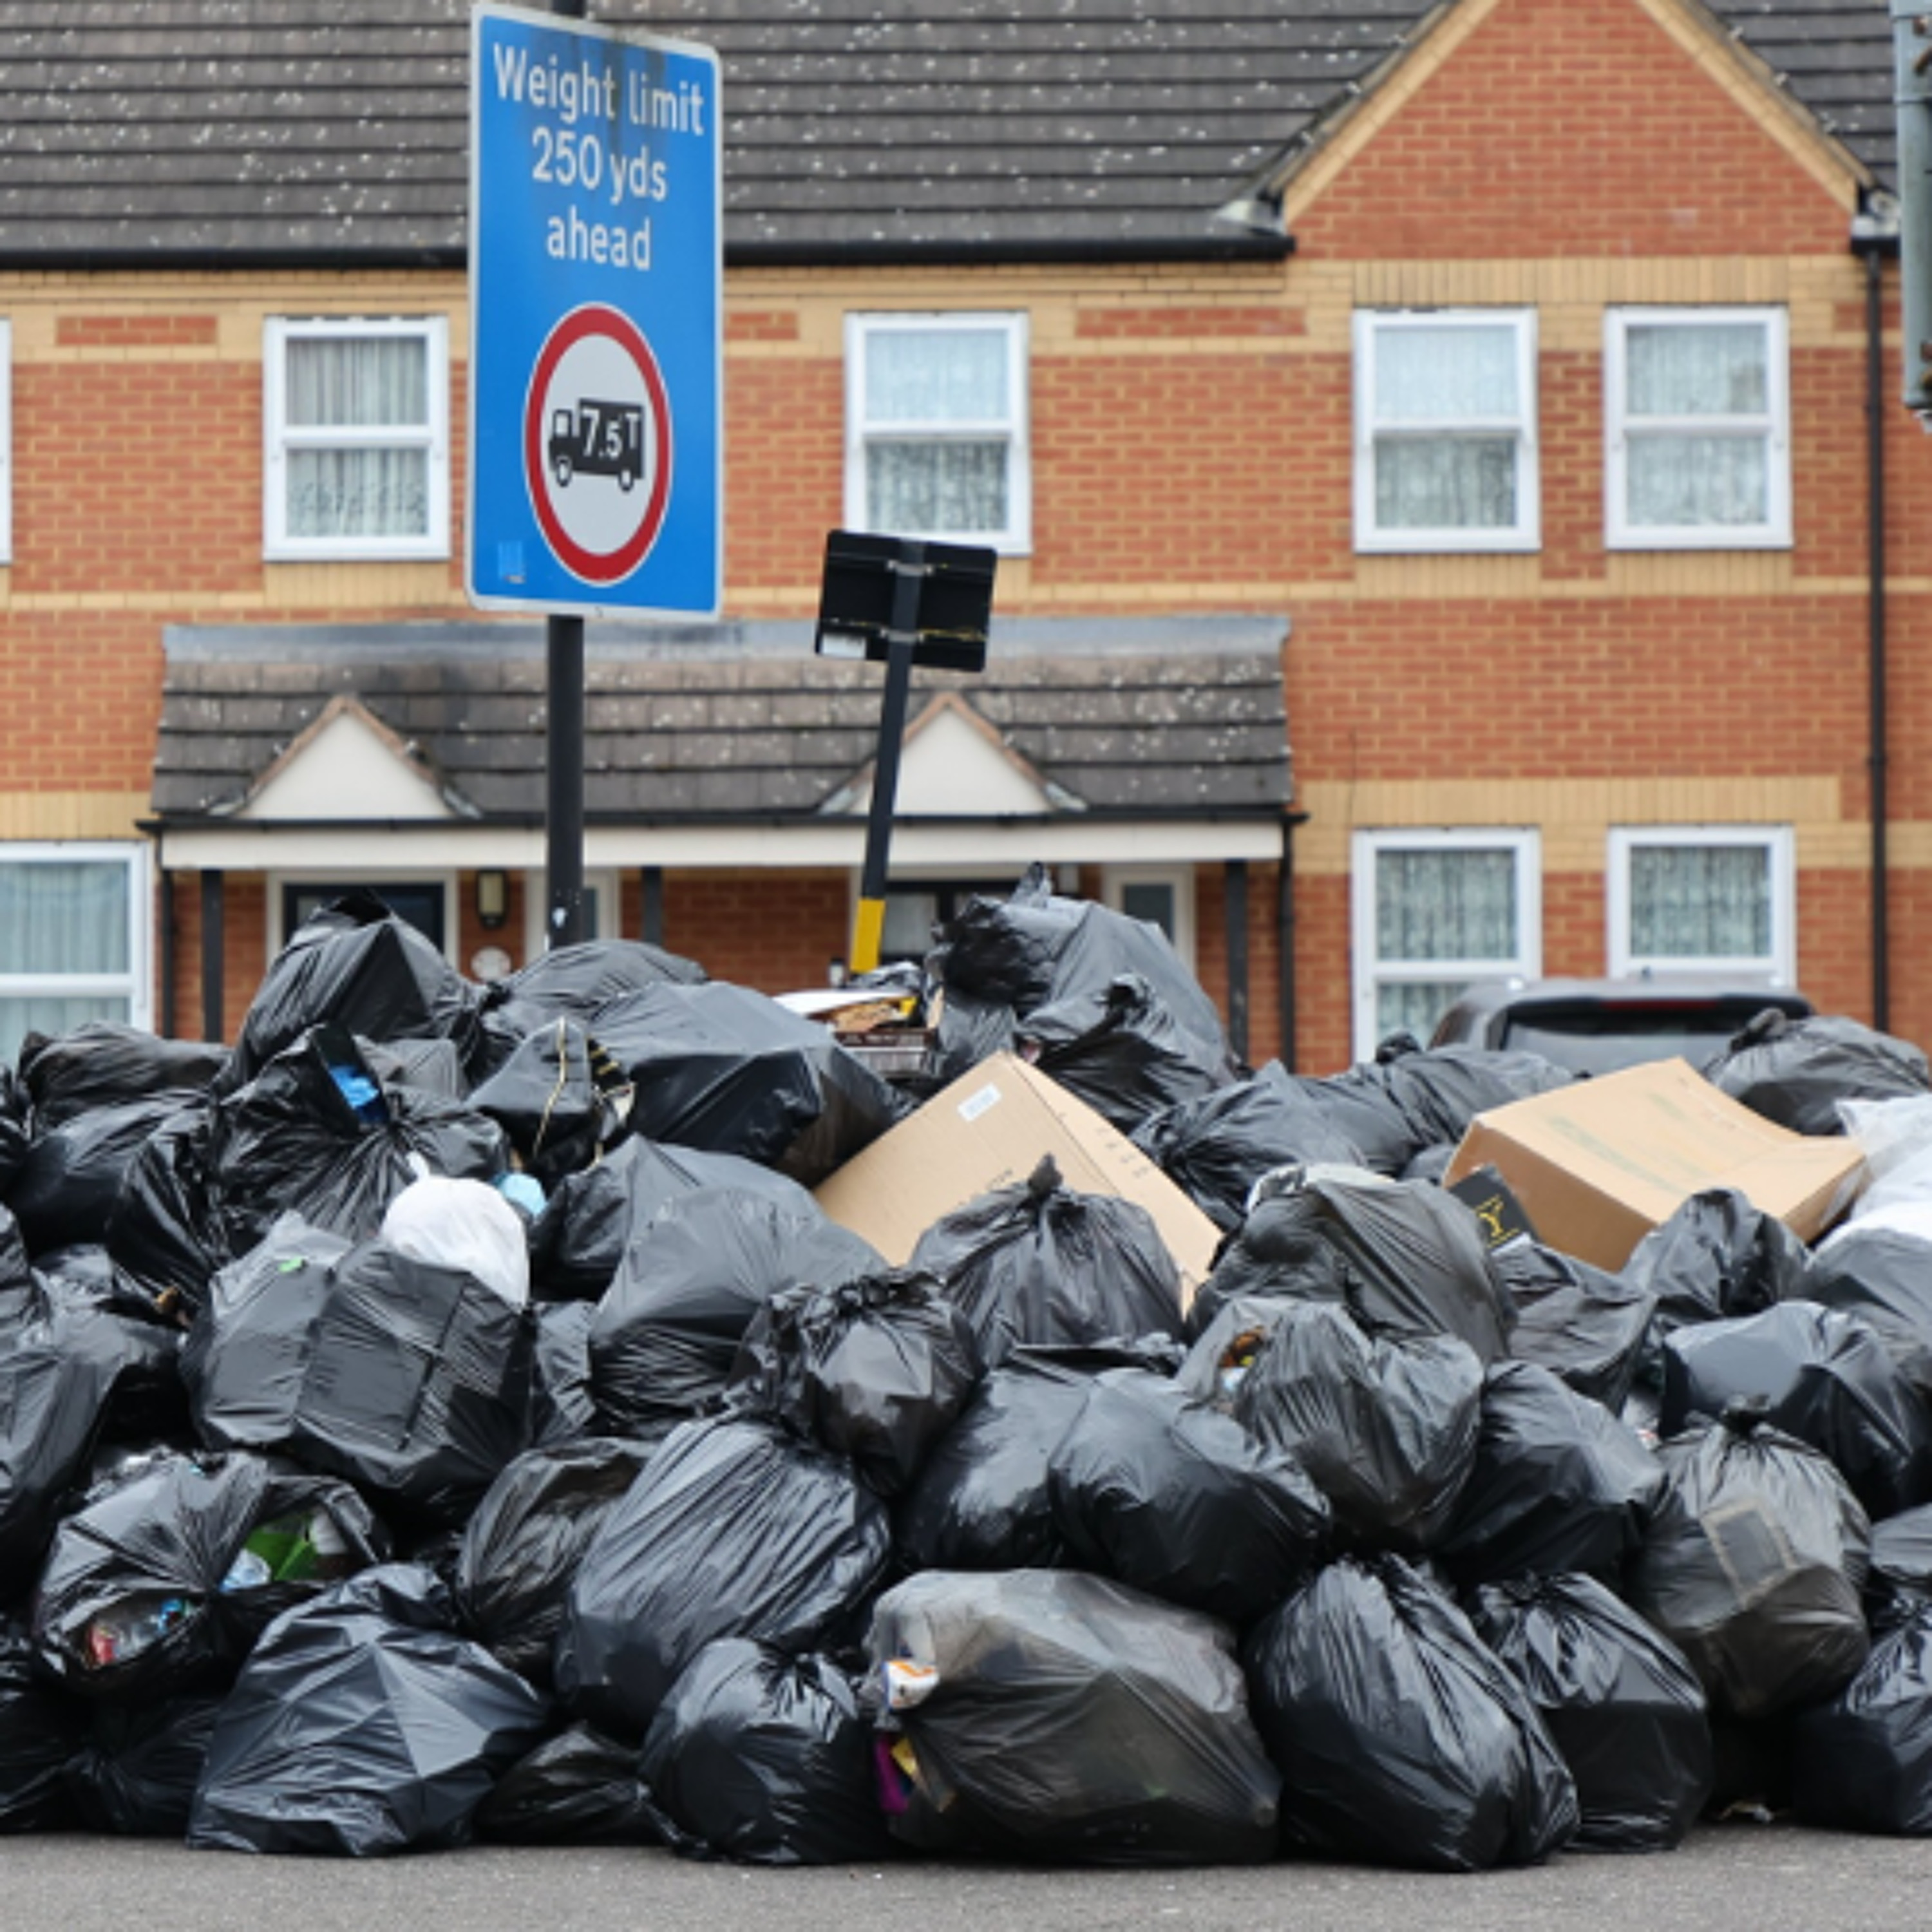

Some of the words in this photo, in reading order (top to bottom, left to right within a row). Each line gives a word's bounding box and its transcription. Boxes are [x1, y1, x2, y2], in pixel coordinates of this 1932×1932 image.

[493, 42, 616, 124] Weight
[629, 69, 704, 136] limit
[532, 126, 602, 189] 250
[610, 146, 667, 205] yds
[547, 204, 650, 270] ahead
